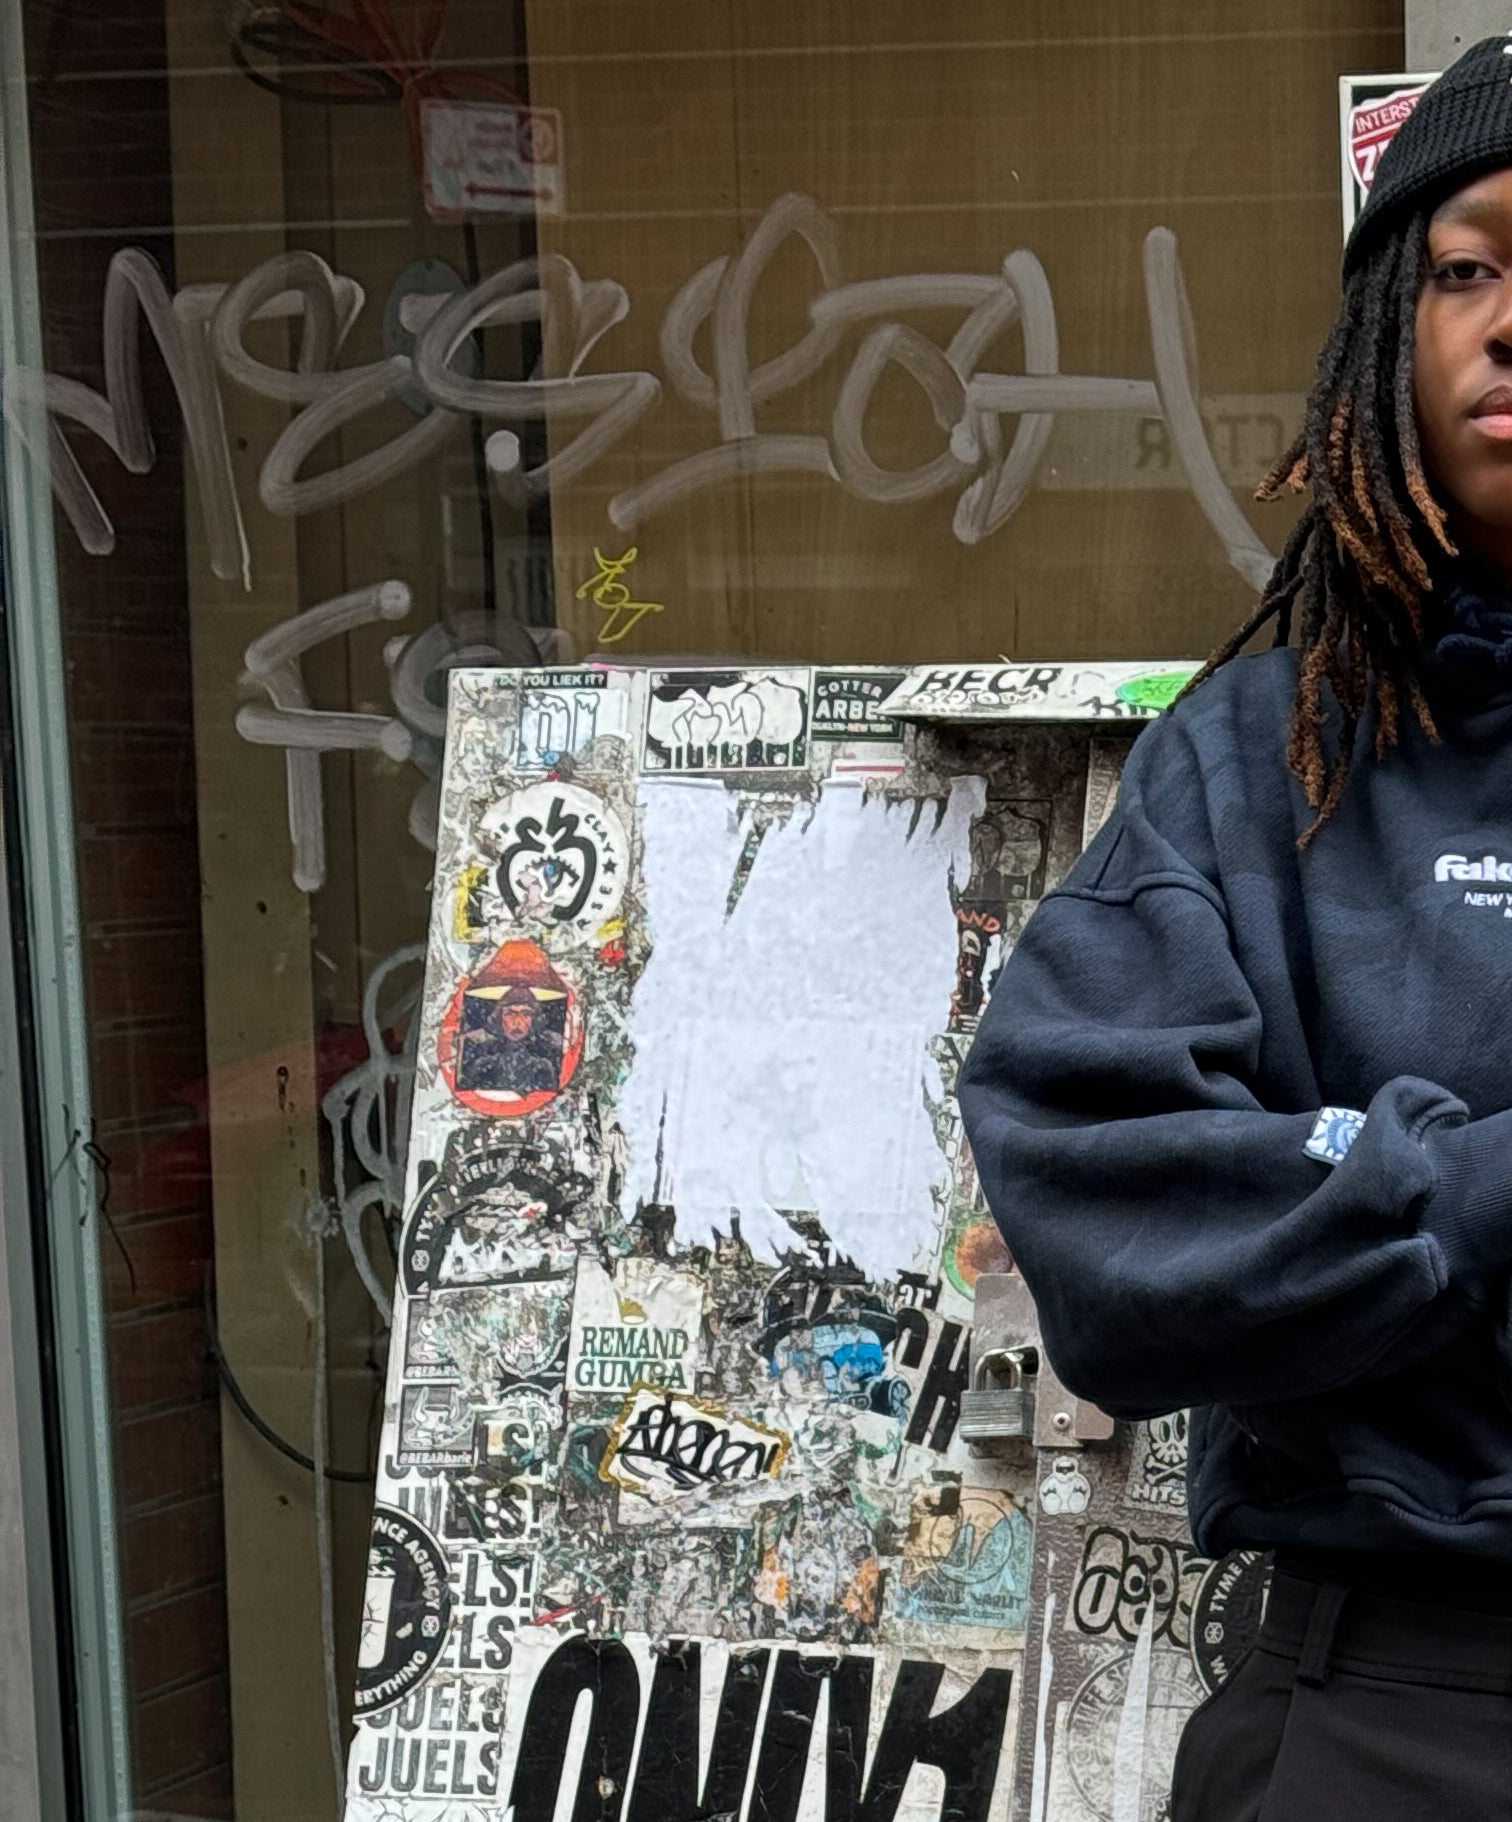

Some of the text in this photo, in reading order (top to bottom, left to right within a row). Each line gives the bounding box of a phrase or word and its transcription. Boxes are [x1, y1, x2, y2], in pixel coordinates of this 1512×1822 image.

[522, 674, 551, 688] YOU
[551, 674, 582, 687] LIEK
[817, 679, 883, 699] COTTER
[815, 699, 887, 722] ARBE
[1464, 891, 1504, 907] NEW
[580, 1326, 690, 1360] REMAND
[573, 1358, 689, 1392] GUMBA
[398, 1528, 443, 1610] AGENCY
